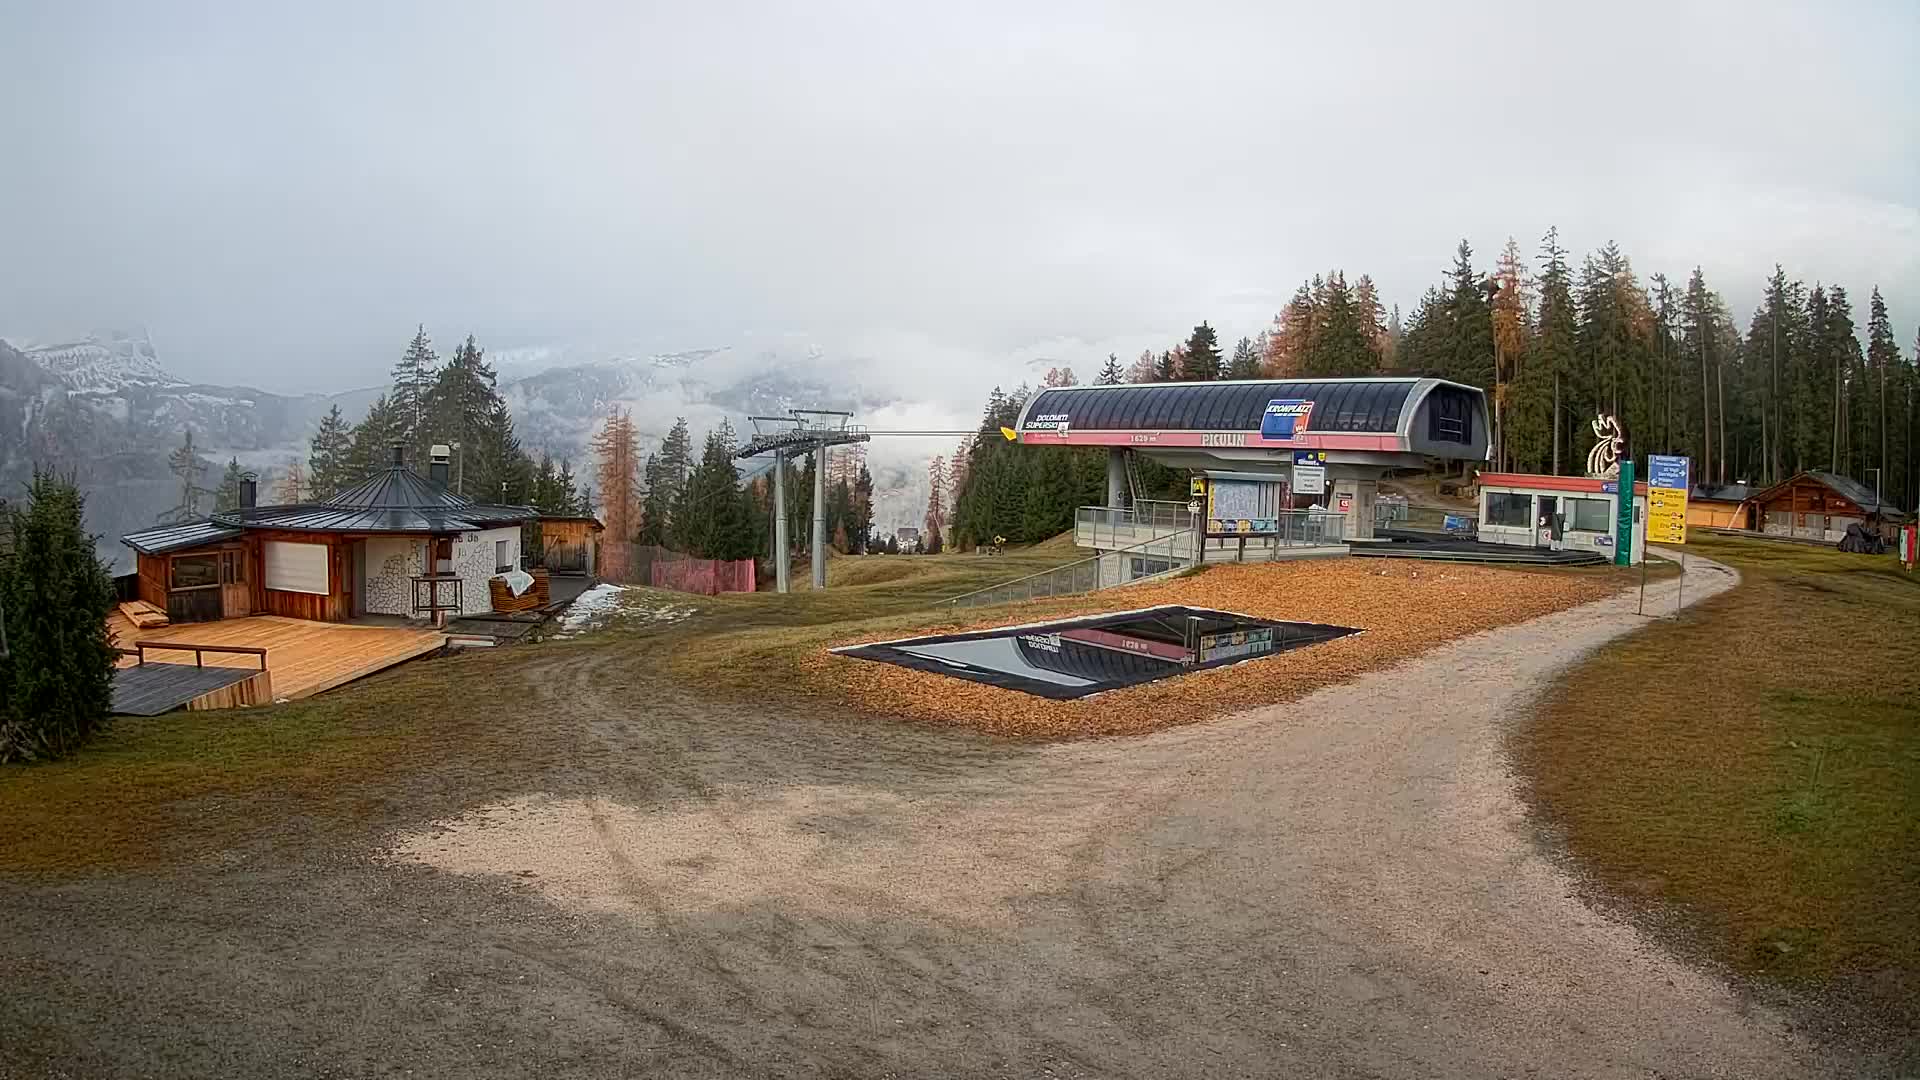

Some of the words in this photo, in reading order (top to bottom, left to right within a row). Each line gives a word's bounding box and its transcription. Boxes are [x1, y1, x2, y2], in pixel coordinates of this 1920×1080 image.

[1036, 414, 1069, 422] DOLOMITI
[1026, 421, 1058, 429] SUPERSKI
[1202, 433, 1245, 447] PICULIN
